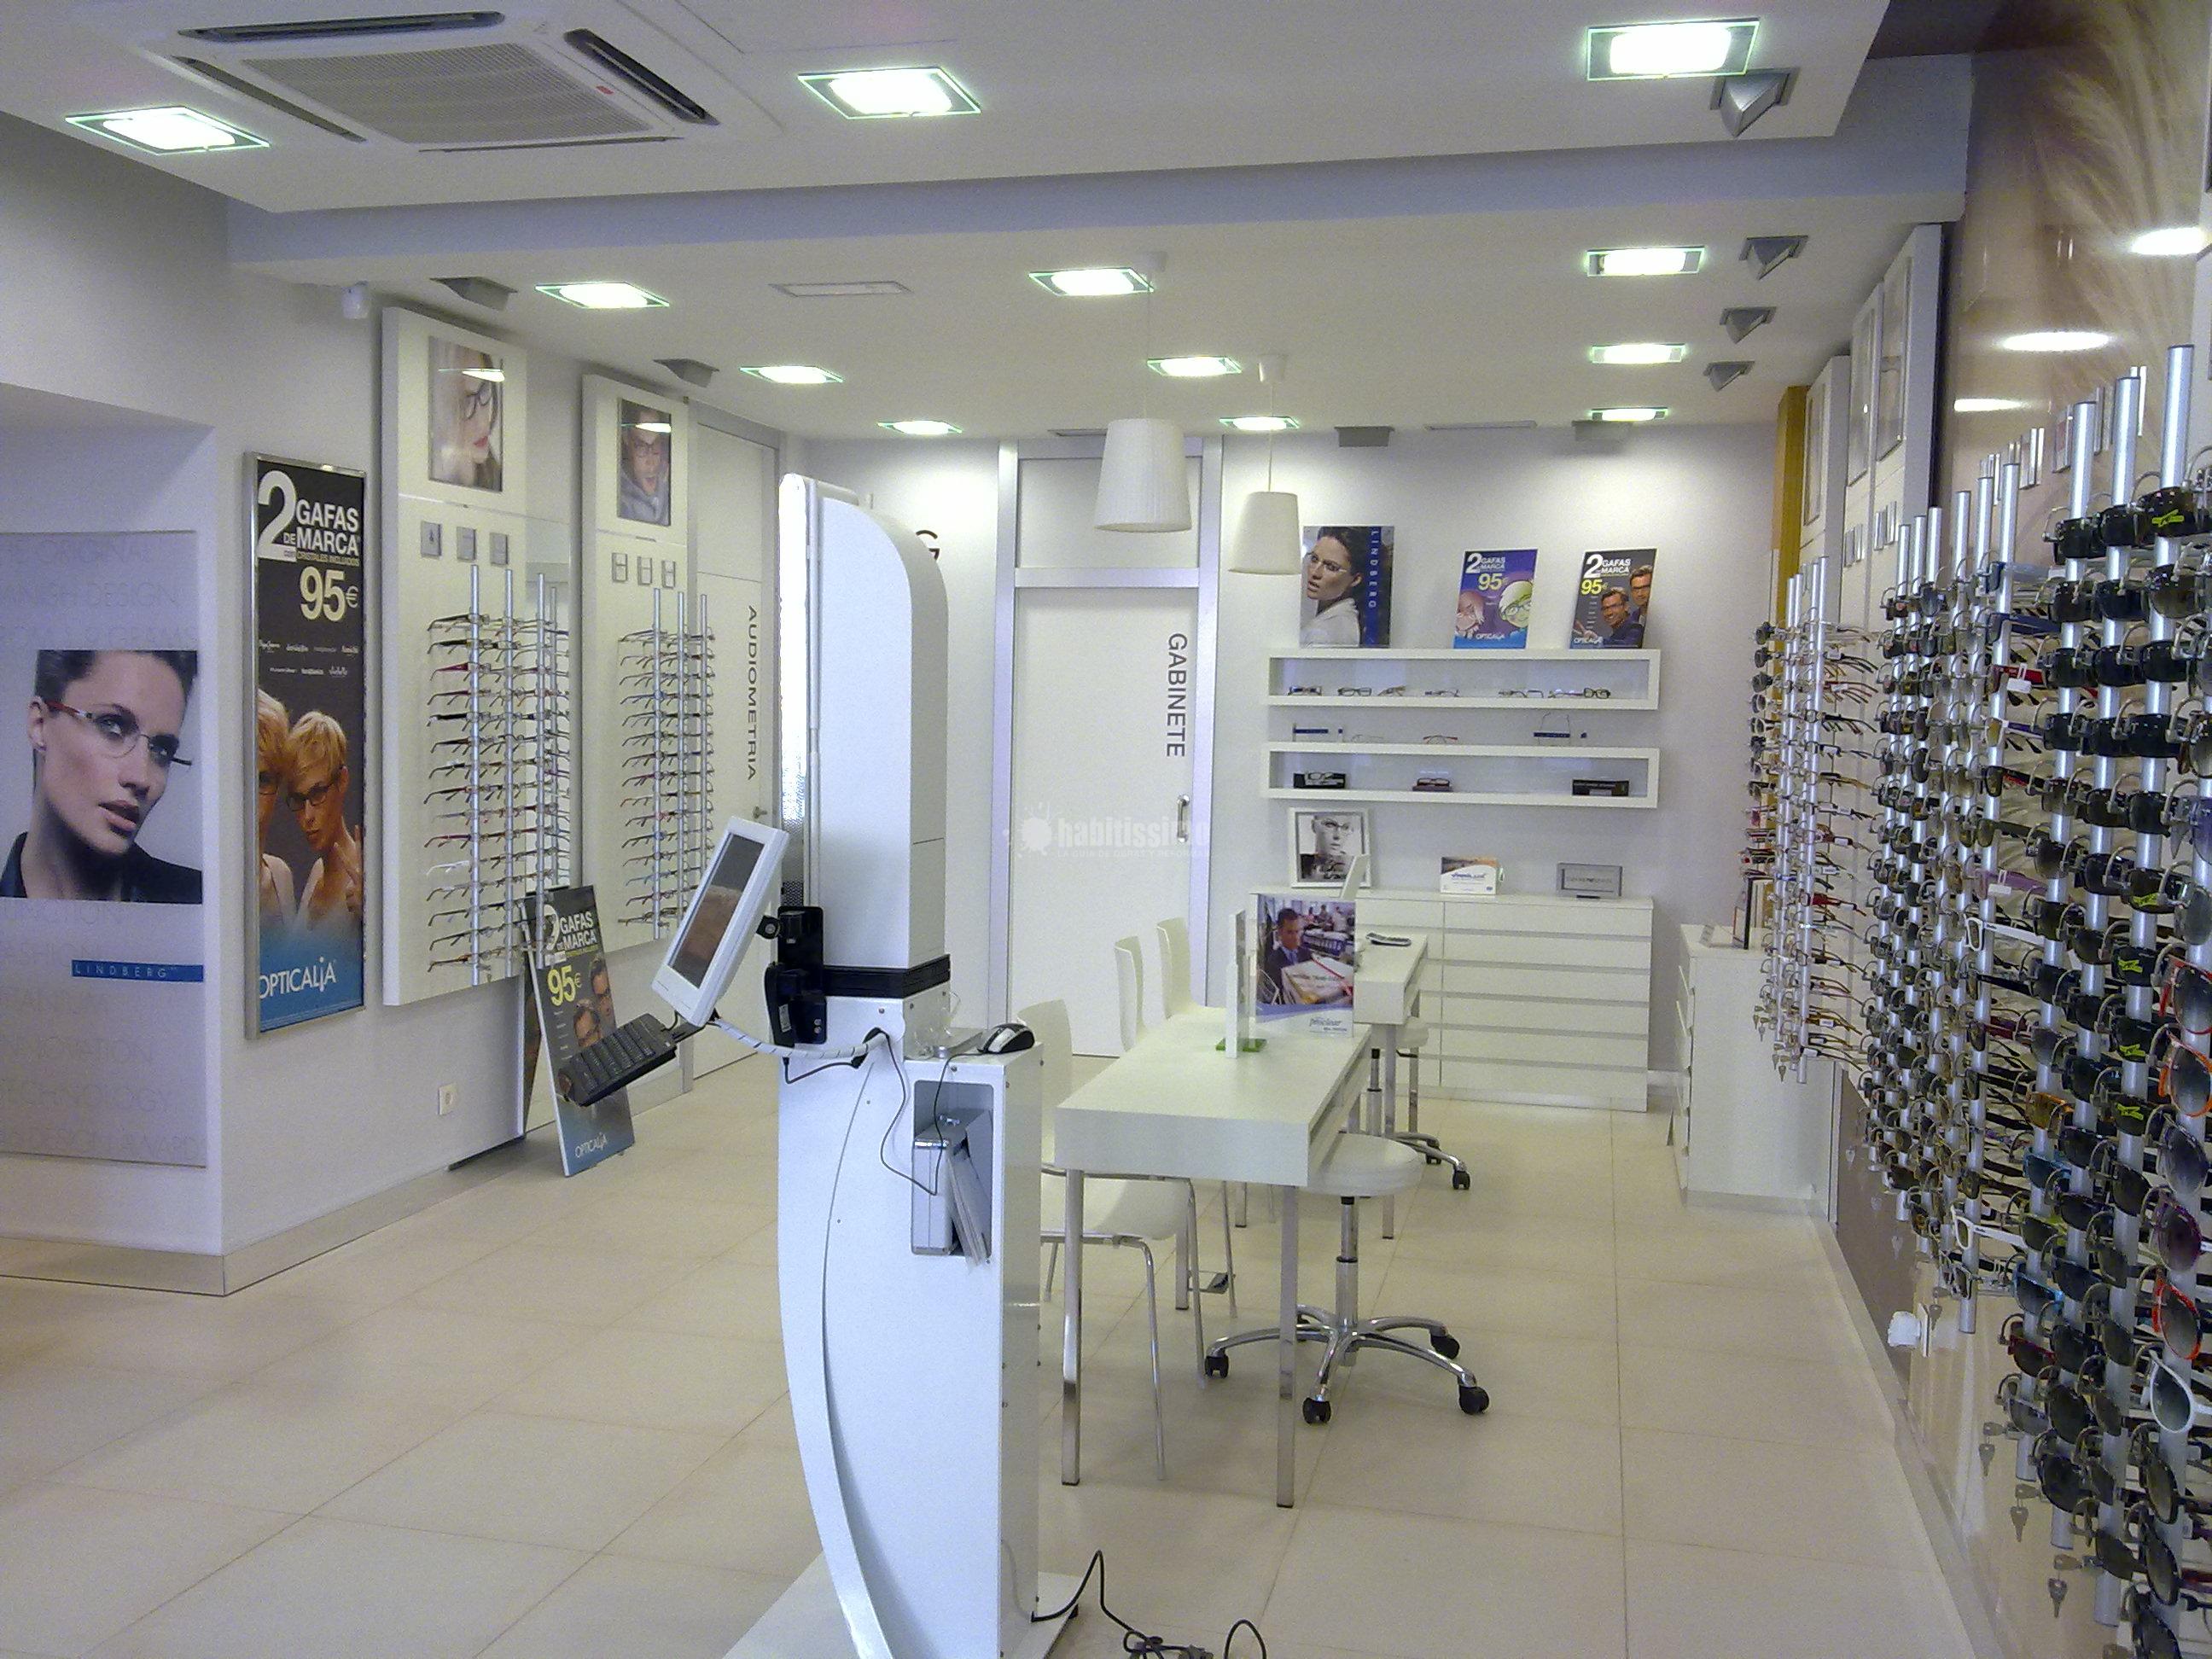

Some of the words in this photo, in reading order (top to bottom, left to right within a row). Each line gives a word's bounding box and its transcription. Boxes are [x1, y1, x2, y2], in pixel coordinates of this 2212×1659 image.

[258, 470, 297, 562] 2
[296, 499, 359, 533] GAFAS
[283, 532, 296, 546] DE
[296, 527, 359, 556] MARCA
[1465, 553, 1482, 573] 2
[1583, 554, 1604, 578] 2
[1602, 558, 1632, 567] GAFAS
[748, 605, 758, 780] AUDIOMETRIA
[1167, 632, 1188, 757] GABINETE
[560, 911, 594, 934] GAFAS
[563, 929, 597, 950] MARCA
[74, 965, 167, 978] LINDBERG
